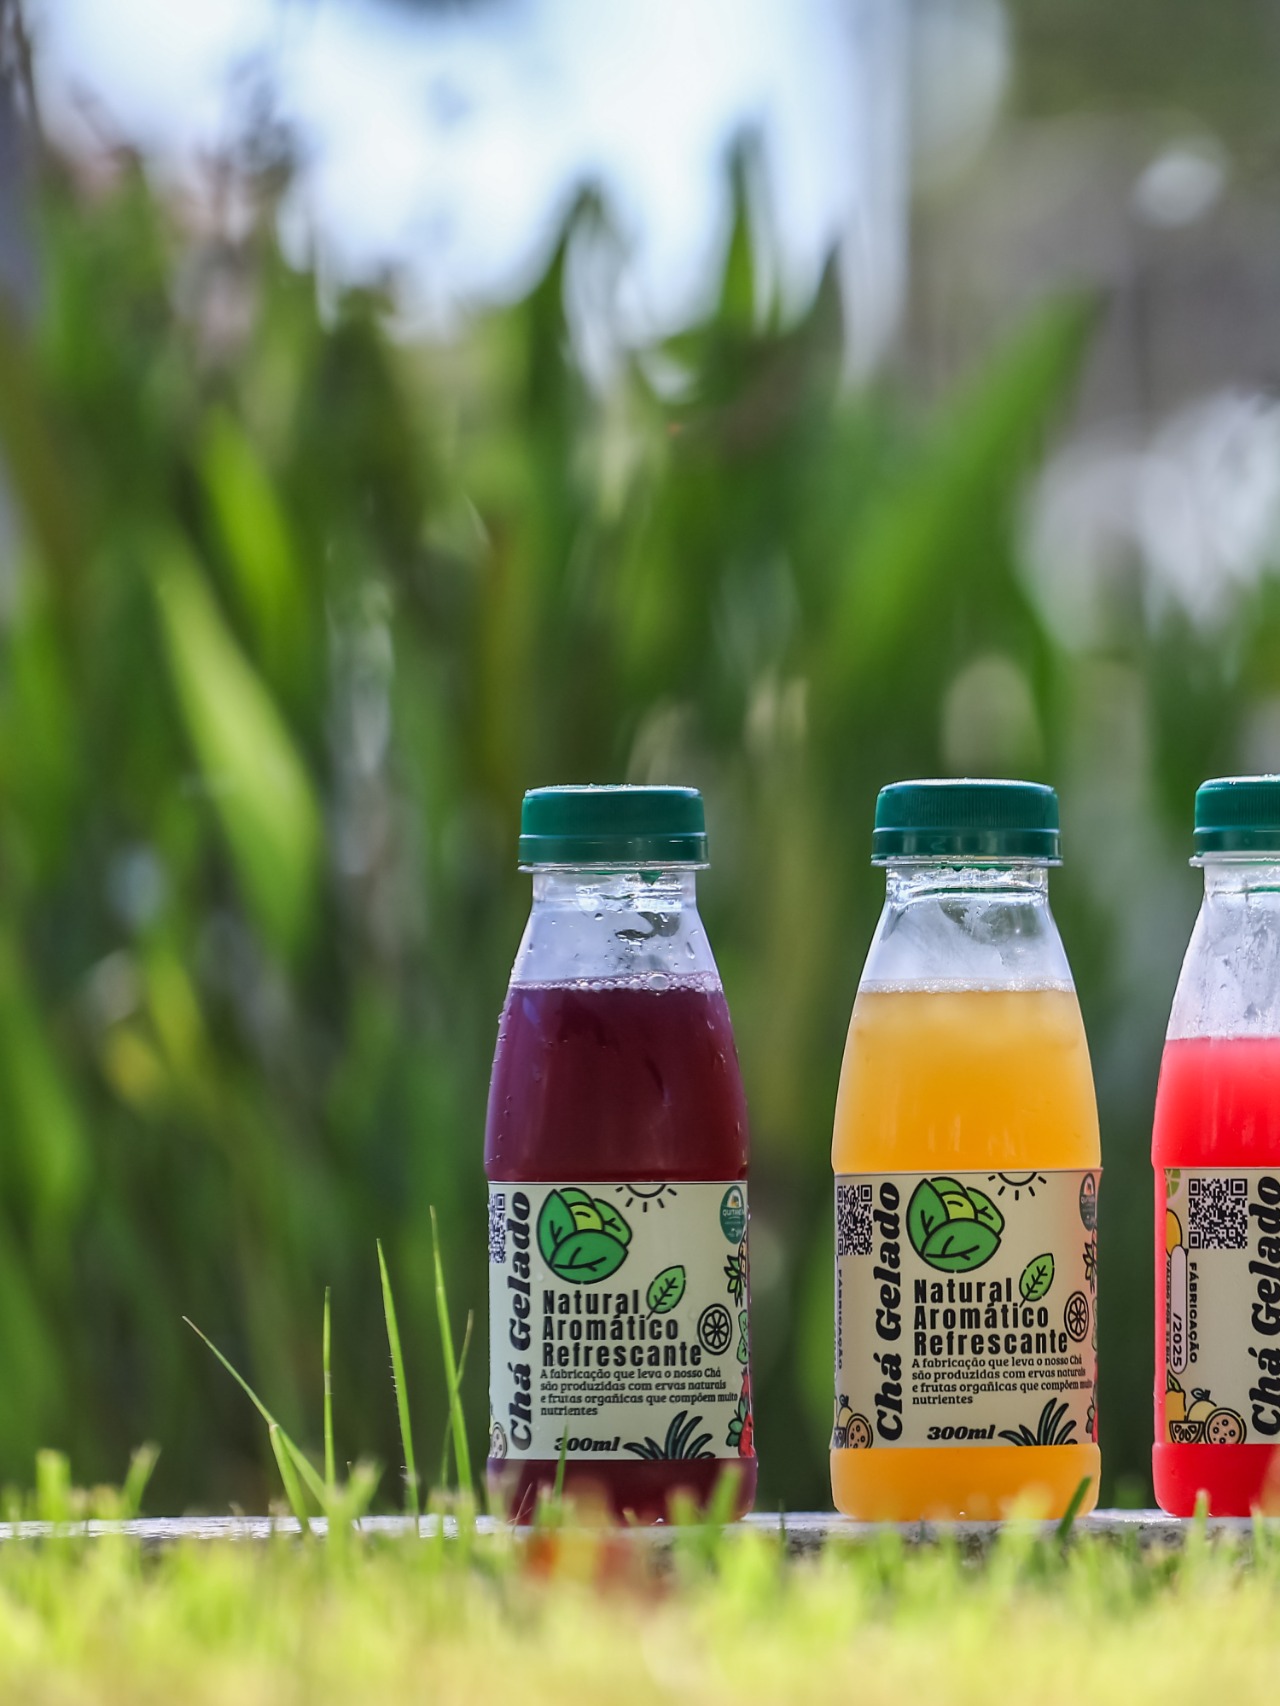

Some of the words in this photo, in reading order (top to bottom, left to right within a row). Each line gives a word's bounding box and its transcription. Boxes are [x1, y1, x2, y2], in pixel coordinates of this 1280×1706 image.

[507, 1192, 531, 1351] Gelado
[873, 1182, 901, 1340] Gelado
[543, 1290, 639, 1314] Natural
[914, 1278, 1012, 1304] Natural
[914, 1301, 1048, 1330] Aromático
[1189, 1262, 1199, 1363] FÁBRICAÇÃO
[542, 1311, 678, 1340] Aromático
[914, 1330, 1068, 1356] Refrescante
[1173, 1312, 1182, 1367] /2025
[543, 1342, 702, 1366] Refrescante
[912, 1359, 920, 1368] A
[923, 1358, 986, 1370] fabricação
[989, 1360, 1008, 1370] que
[1012, 1357, 1034, 1366] leva
[1037, 1358, 1043, 1366] o
[1045, 1358, 1068, 1366] nosso
[1070, 1355, 1082, 1364] Chá
[540, 1369, 548, 1379] A
[550, 1369, 610, 1381] fabricação
[614, 1371, 635, 1381] que
[638, 1369, 662, 1378] leva
[674, 1370, 702, 1378] nosso
[704, 1367, 721, 1378] Chá
[912, 1370, 931, 1380] são
[934, 1369, 1000, 1382] produzidas
[1003, 1371, 1025, 1379] com
[1028, 1370, 1055, 1378] ervas
[541, 1382, 557, 1391] são
[561, 1381, 625, 1393] produzidas
[628, 1383, 651, 1391] com
[655, 1382, 685, 1390] ervas
[688, 1380, 726, 1390] naturais
[874, 1352, 902, 1440] Chá
[912, 1384, 918, 1392] e
[921, 1382, 956, 1393] frutas
[1020, 1383, 1039, 1393] que
[1041, 1380, 1078, 1392] compõem
[508, 1362, 532, 1450] Chá
[541, 1406, 598, 1415] nutrientes
[548, 1394, 582, 1403] frutas
[646, 1395, 666, 1405] que
[669, 1393, 715, 1405] compõem
[912, 1395, 973, 1404] nutrientes
[554, 1437, 620, 1451] 300ml
[927, 1424, 996, 1440] 300ml
